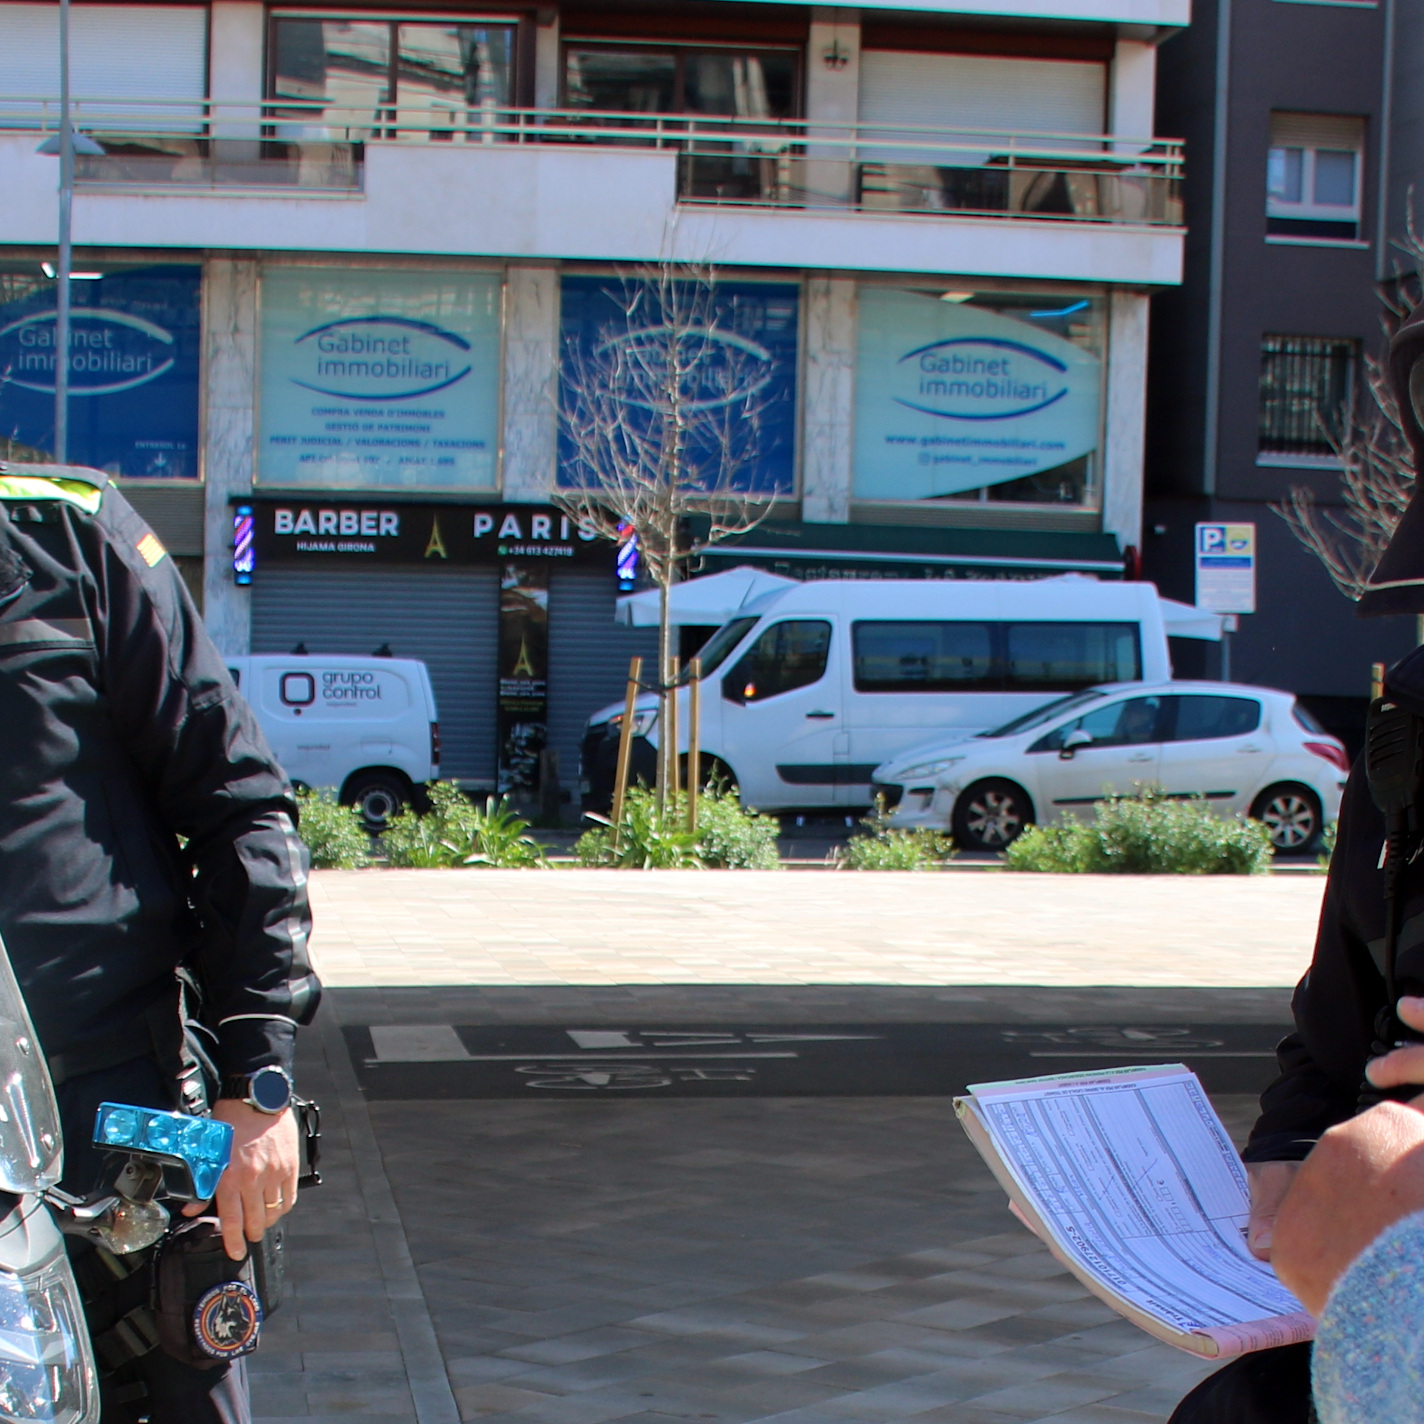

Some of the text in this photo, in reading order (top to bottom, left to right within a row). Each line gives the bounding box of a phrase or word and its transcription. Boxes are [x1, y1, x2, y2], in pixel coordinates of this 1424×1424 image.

[19, 326, 113, 348] Ganet
[317, 332, 410, 355] Gabinet
[317, 356, 449, 379] immobiliari
[919, 352, 1011, 376] Gabinet
[919, 376, 1046, 400] immobiliari
[311, 407, 350, 418] COMPRA
[353, 408, 384, 419] VENDA
[362, 424, 374, 433] DE
[377, 424, 431, 435] PATRIMONI
[270, 435, 296, 446] PERIT
[299, 436, 343, 447] JUDICIAL
[355, 437, 420, 449] VALORACIONS
[432, 440, 486, 451] TAXACIONS
[885, 434, 1065, 451] www.gabinetimmobiliari.com
[274, 508, 596, 541] BARBER PARIS
[297, 541, 375, 553] HIJAMA GIRONA
[1201, 528, 1222, 552] P
[322, 671, 374, 687] grupo
[322, 684, 382, 700] control
